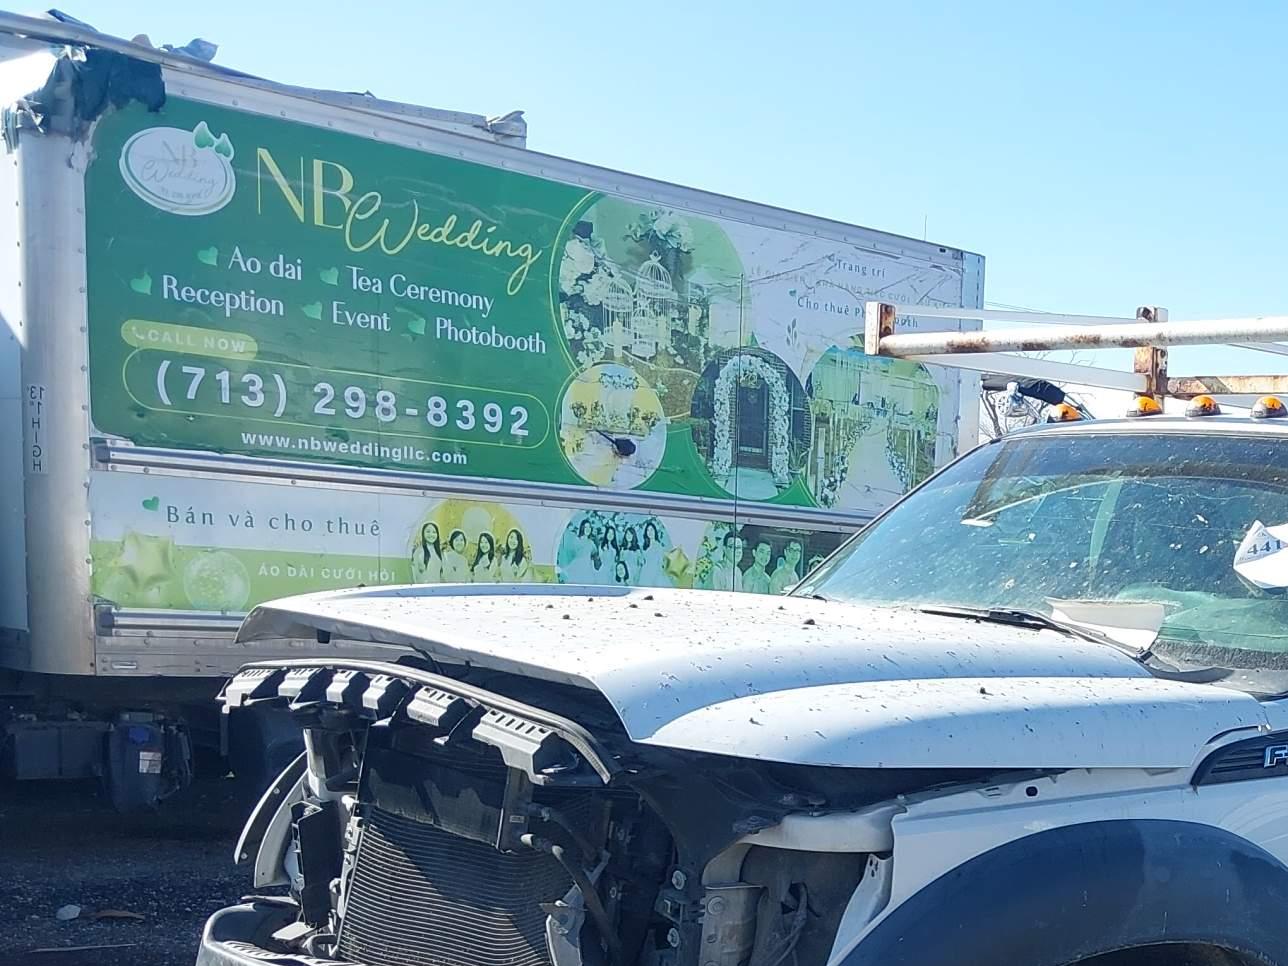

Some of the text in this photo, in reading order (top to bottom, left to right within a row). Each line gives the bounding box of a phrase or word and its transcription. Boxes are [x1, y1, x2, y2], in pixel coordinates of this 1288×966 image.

[256, 147, 543, 296] NB Wedding
[228, 245, 302, 281] Ao dai
[162, 274, 284, 318] Reception
[345, 265, 495, 319] Tea Ceremony
[797, 297, 819, 312] Cho
[331, 301, 392, 333] Event
[147, 328, 248, 353] CALL NOW
[435, 316, 547, 355] Photobooth
[156, 360, 530, 436] (713) 298-8392
[241, 430, 469, 465] www.nbweddingllc.com
[166, 505, 381, 537] Bán và cho thuê
